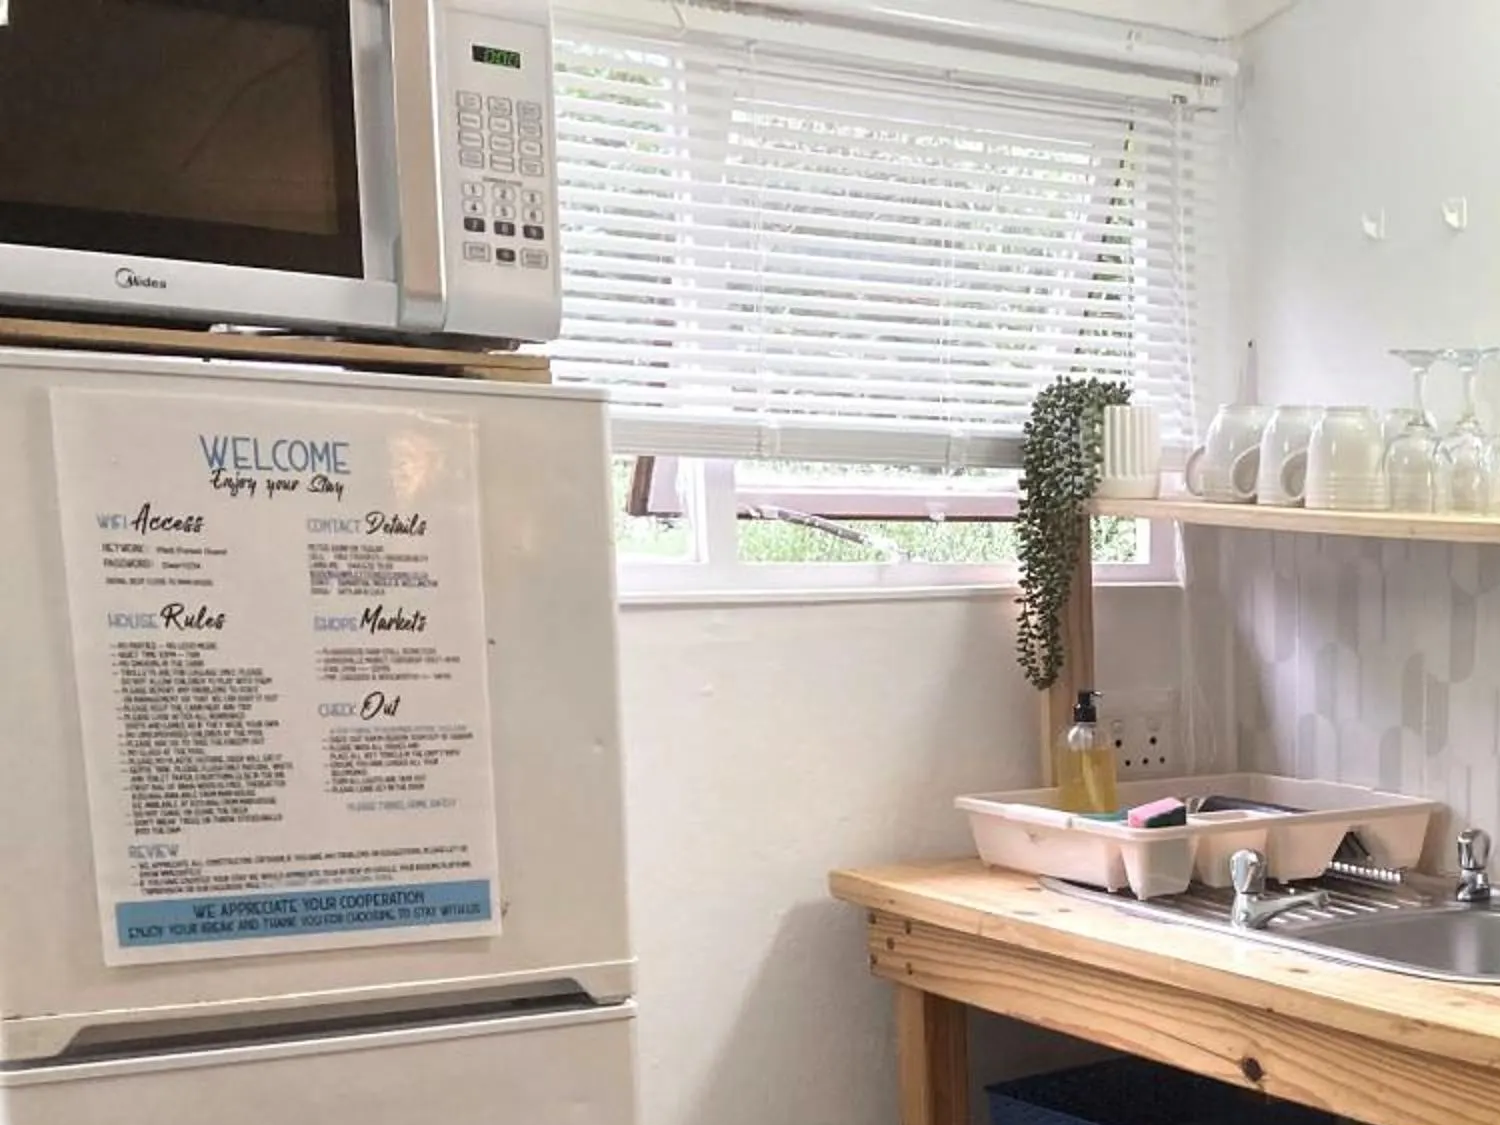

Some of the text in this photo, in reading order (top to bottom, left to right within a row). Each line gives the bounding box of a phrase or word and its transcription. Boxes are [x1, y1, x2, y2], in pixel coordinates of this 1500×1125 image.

[199, 435, 351, 474] WELCOME
[209, 467, 345, 502] Enjoy your Stay
[130, 503, 205, 536] Access
[365, 510, 428, 537] Details
[160, 602, 227, 631] Rules
[360, 603, 428, 635] Markets
[359, 691, 401, 721] Out
[128, 844, 179, 859] REVIEW
[192, 890, 425, 918] WE APPRECIATE YOUR COOPERATION
